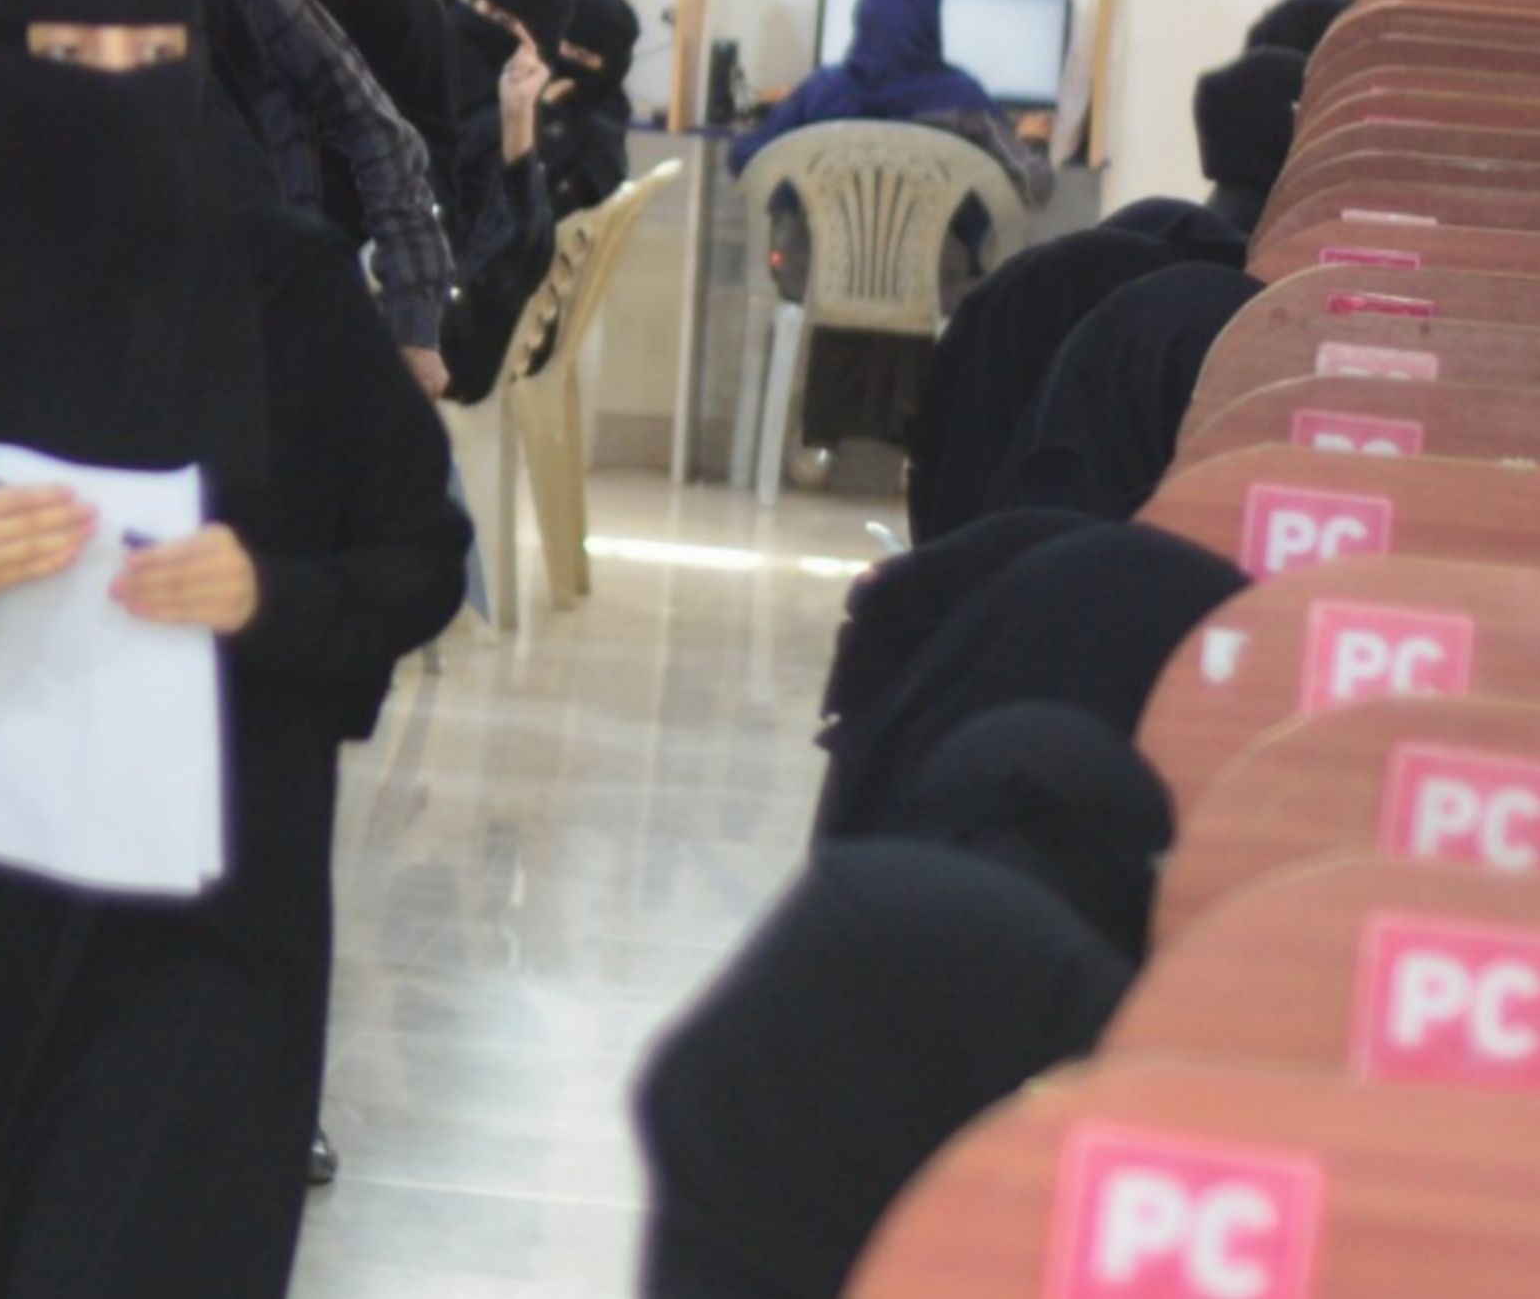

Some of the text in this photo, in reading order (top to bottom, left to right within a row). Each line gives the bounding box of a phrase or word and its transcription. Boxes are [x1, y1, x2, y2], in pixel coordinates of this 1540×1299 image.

[1265, 508, 1367, 570] PC
[1330, 629, 1447, 698] PC
[1411, 775, 1540, 868] PC
[1387, 951, 1540, 1058] PC
[1094, 1167, 1279, 1299] PC
